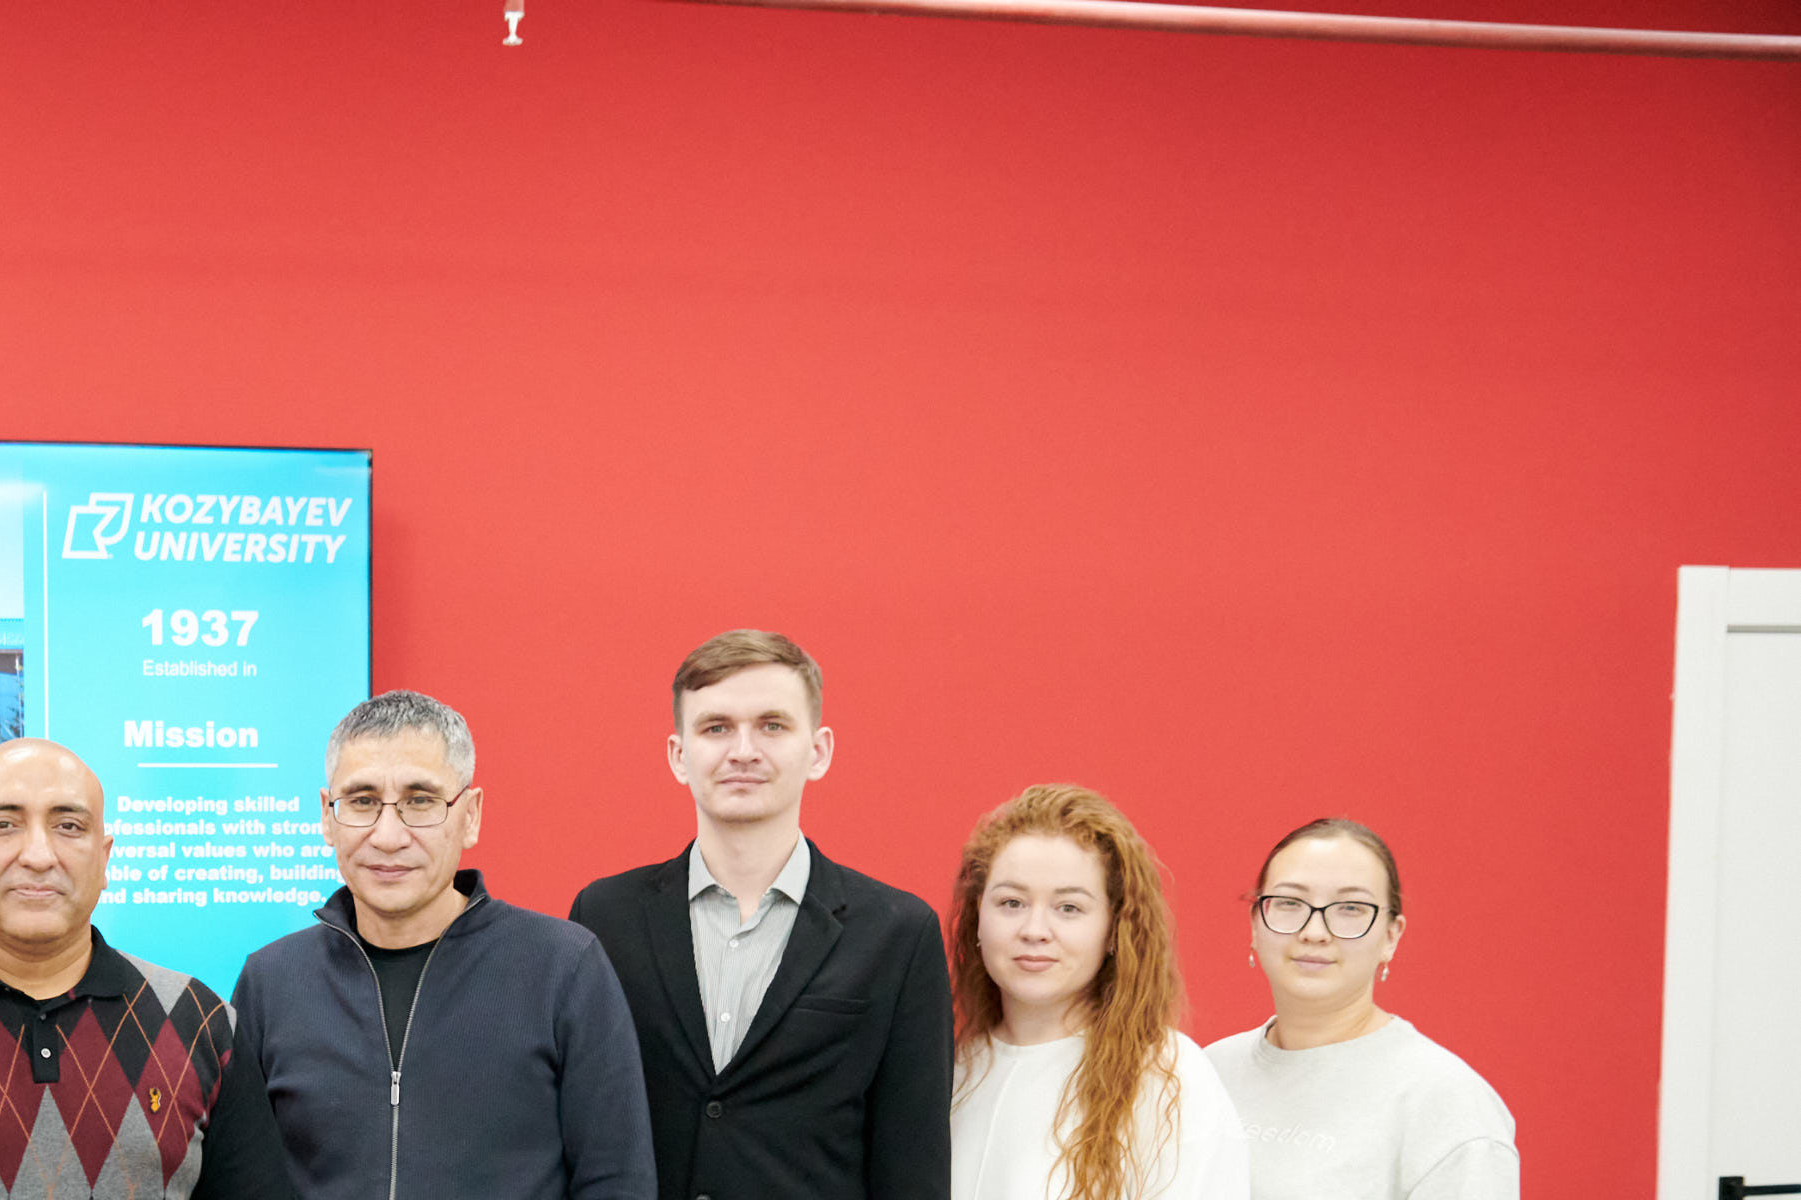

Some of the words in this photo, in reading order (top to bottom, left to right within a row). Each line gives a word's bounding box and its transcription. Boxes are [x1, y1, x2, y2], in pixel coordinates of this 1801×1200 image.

[140, 493, 352, 526] KOZYBAYEV
[134, 531, 346, 563] UNIVERSITY
[142, 608, 259, 646] 1937
[143, 658, 237, 677] Established
[242, 659, 257, 677] in
[124, 721, 259, 747] Mission
[117, 795, 228, 816] Developing
[234, 796, 300, 813] skilled
[104, 819, 217, 835] ofessionals
[222, 819, 266, 835] with
[272, 819, 323, 835] stron
[110, 842, 176, 858] versal
[182, 842, 248, 858] values
[252, 842, 295, 858] who
[300, 845, 331, 858] are
[148, 865, 169, 881] of
[174, 865, 263, 884] creating,
[101, 888, 127, 905] nd
[133, 888, 208, 907] sharing
[214, 888, 328, 907] knowledge.
